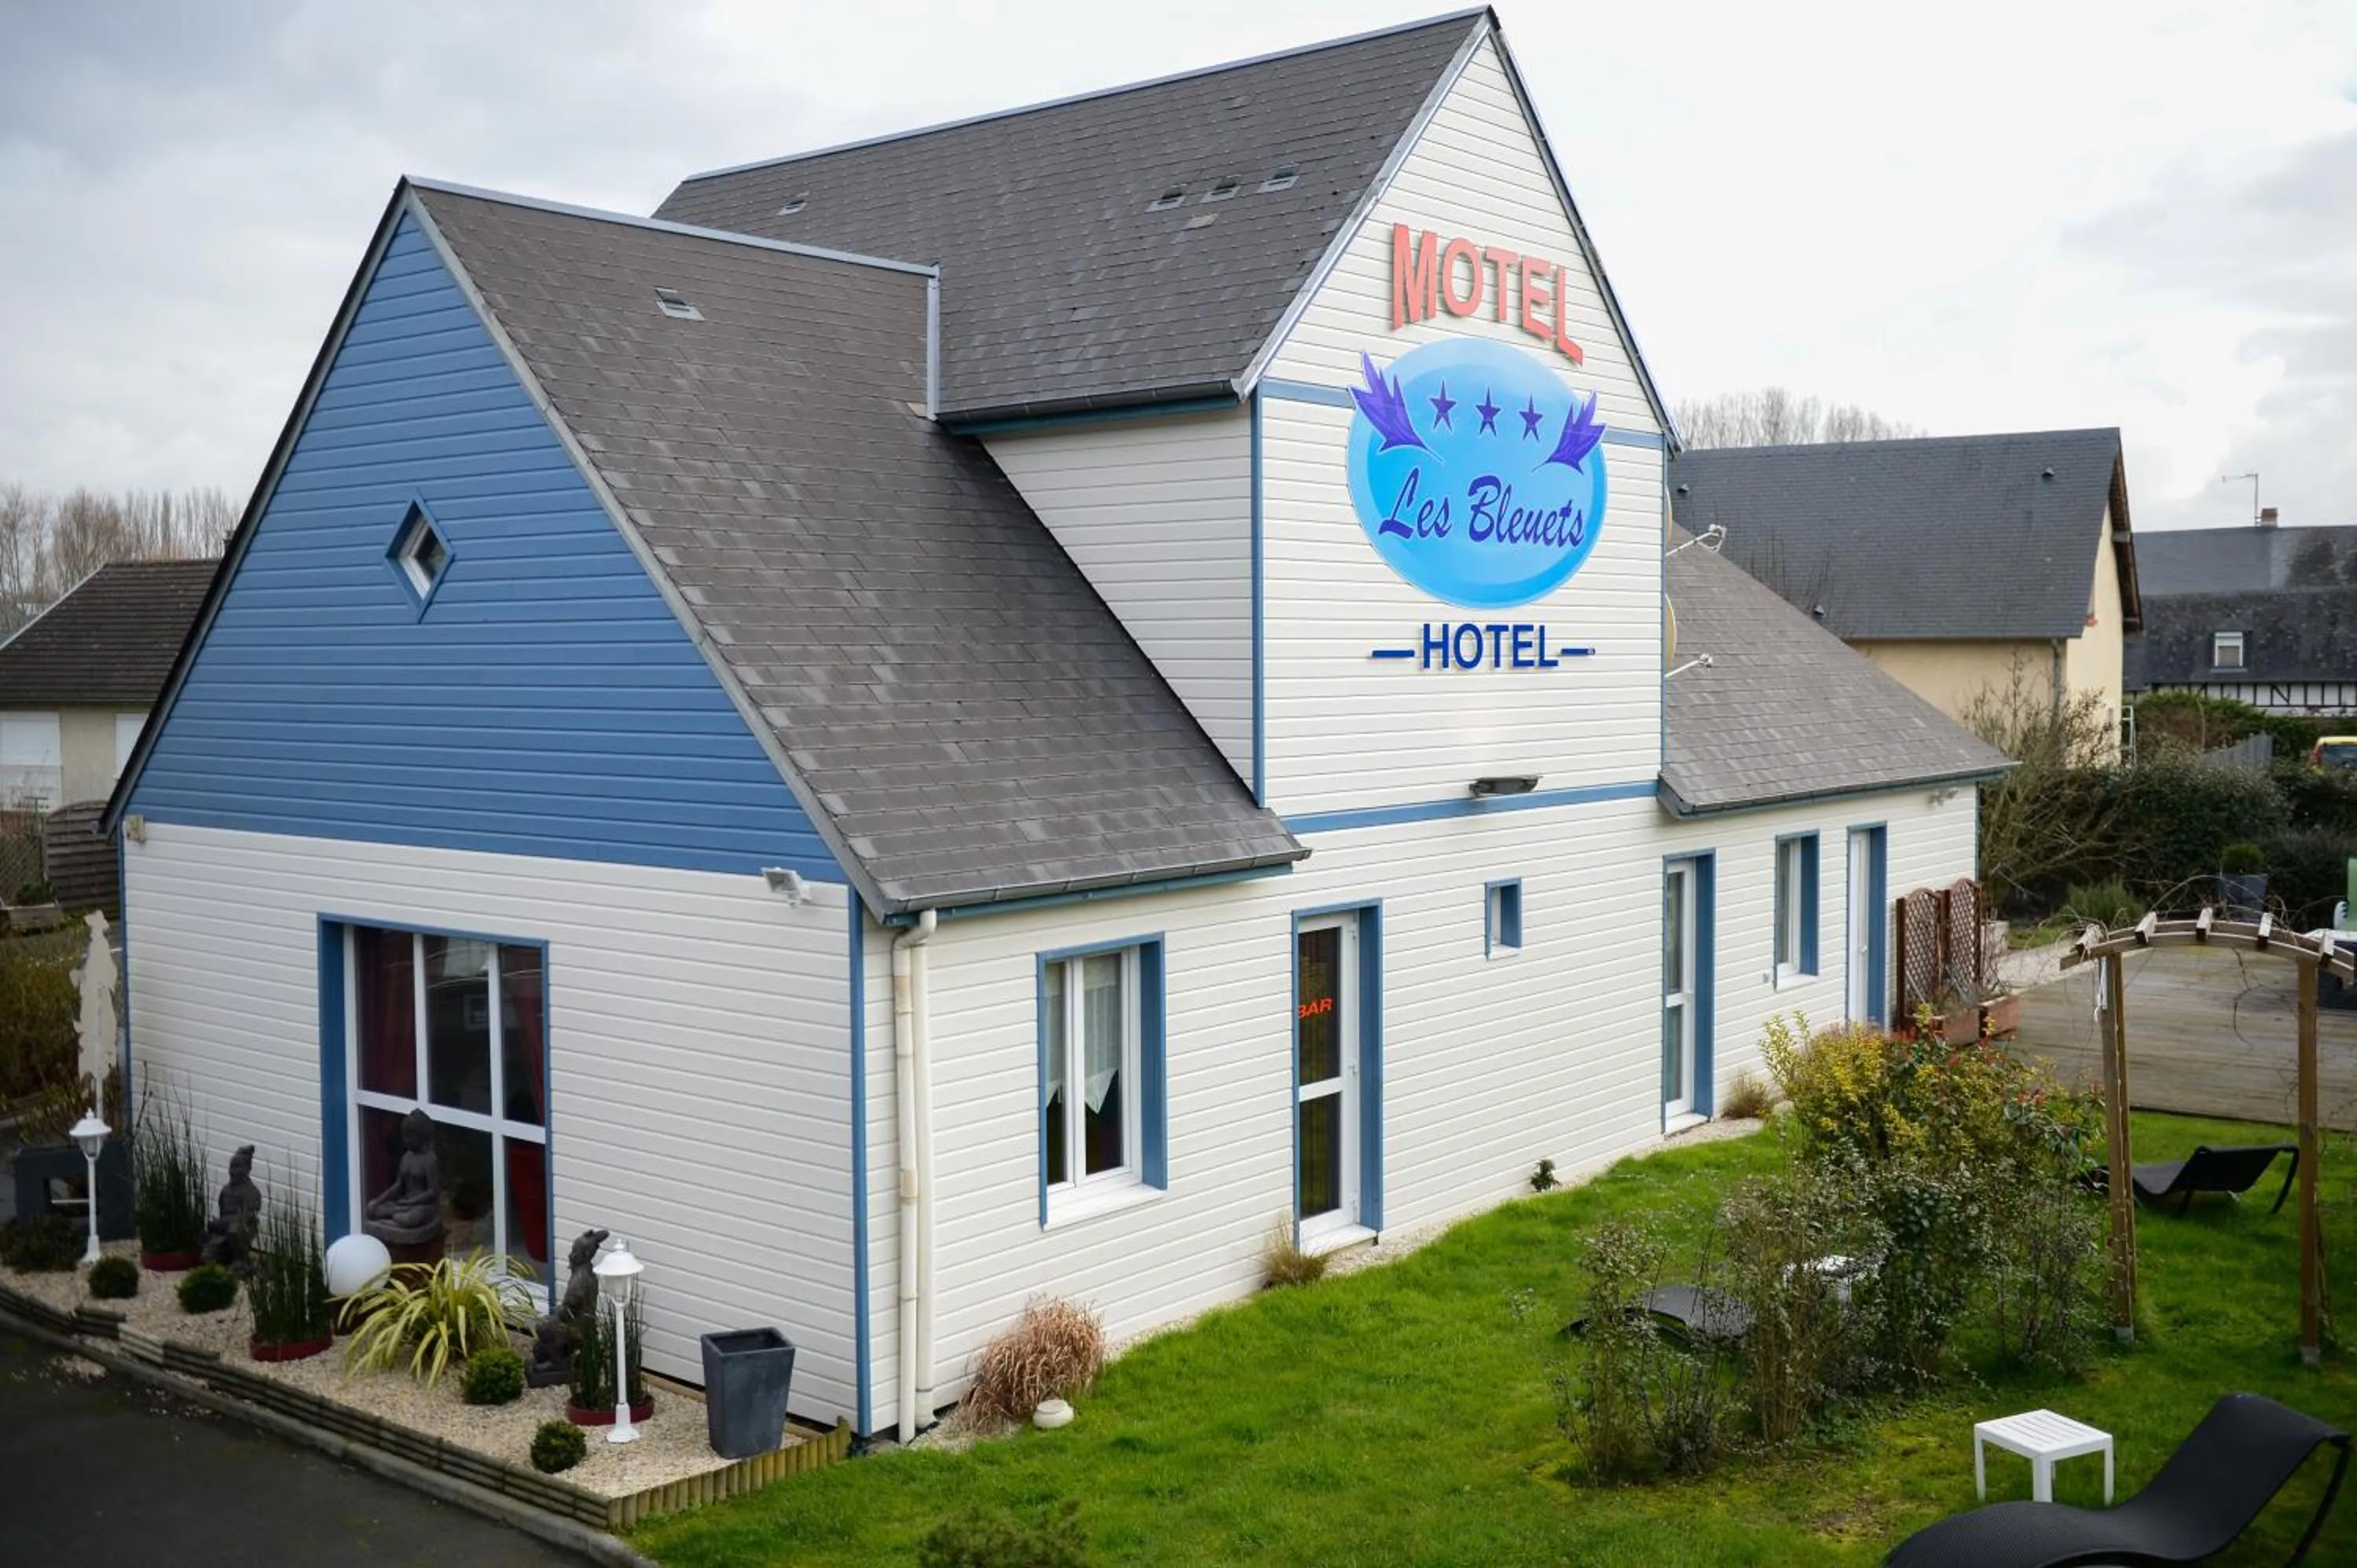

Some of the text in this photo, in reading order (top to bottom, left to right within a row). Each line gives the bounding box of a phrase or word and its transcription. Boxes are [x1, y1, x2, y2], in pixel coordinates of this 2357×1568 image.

[1391, 222, 1583, 365] MOTEL
[1379, 467, 1584, 548] Les Bleuets
[1423, 623, 1560, 669] HOTEL
[1298, 998, 1332, 1018] BAR
